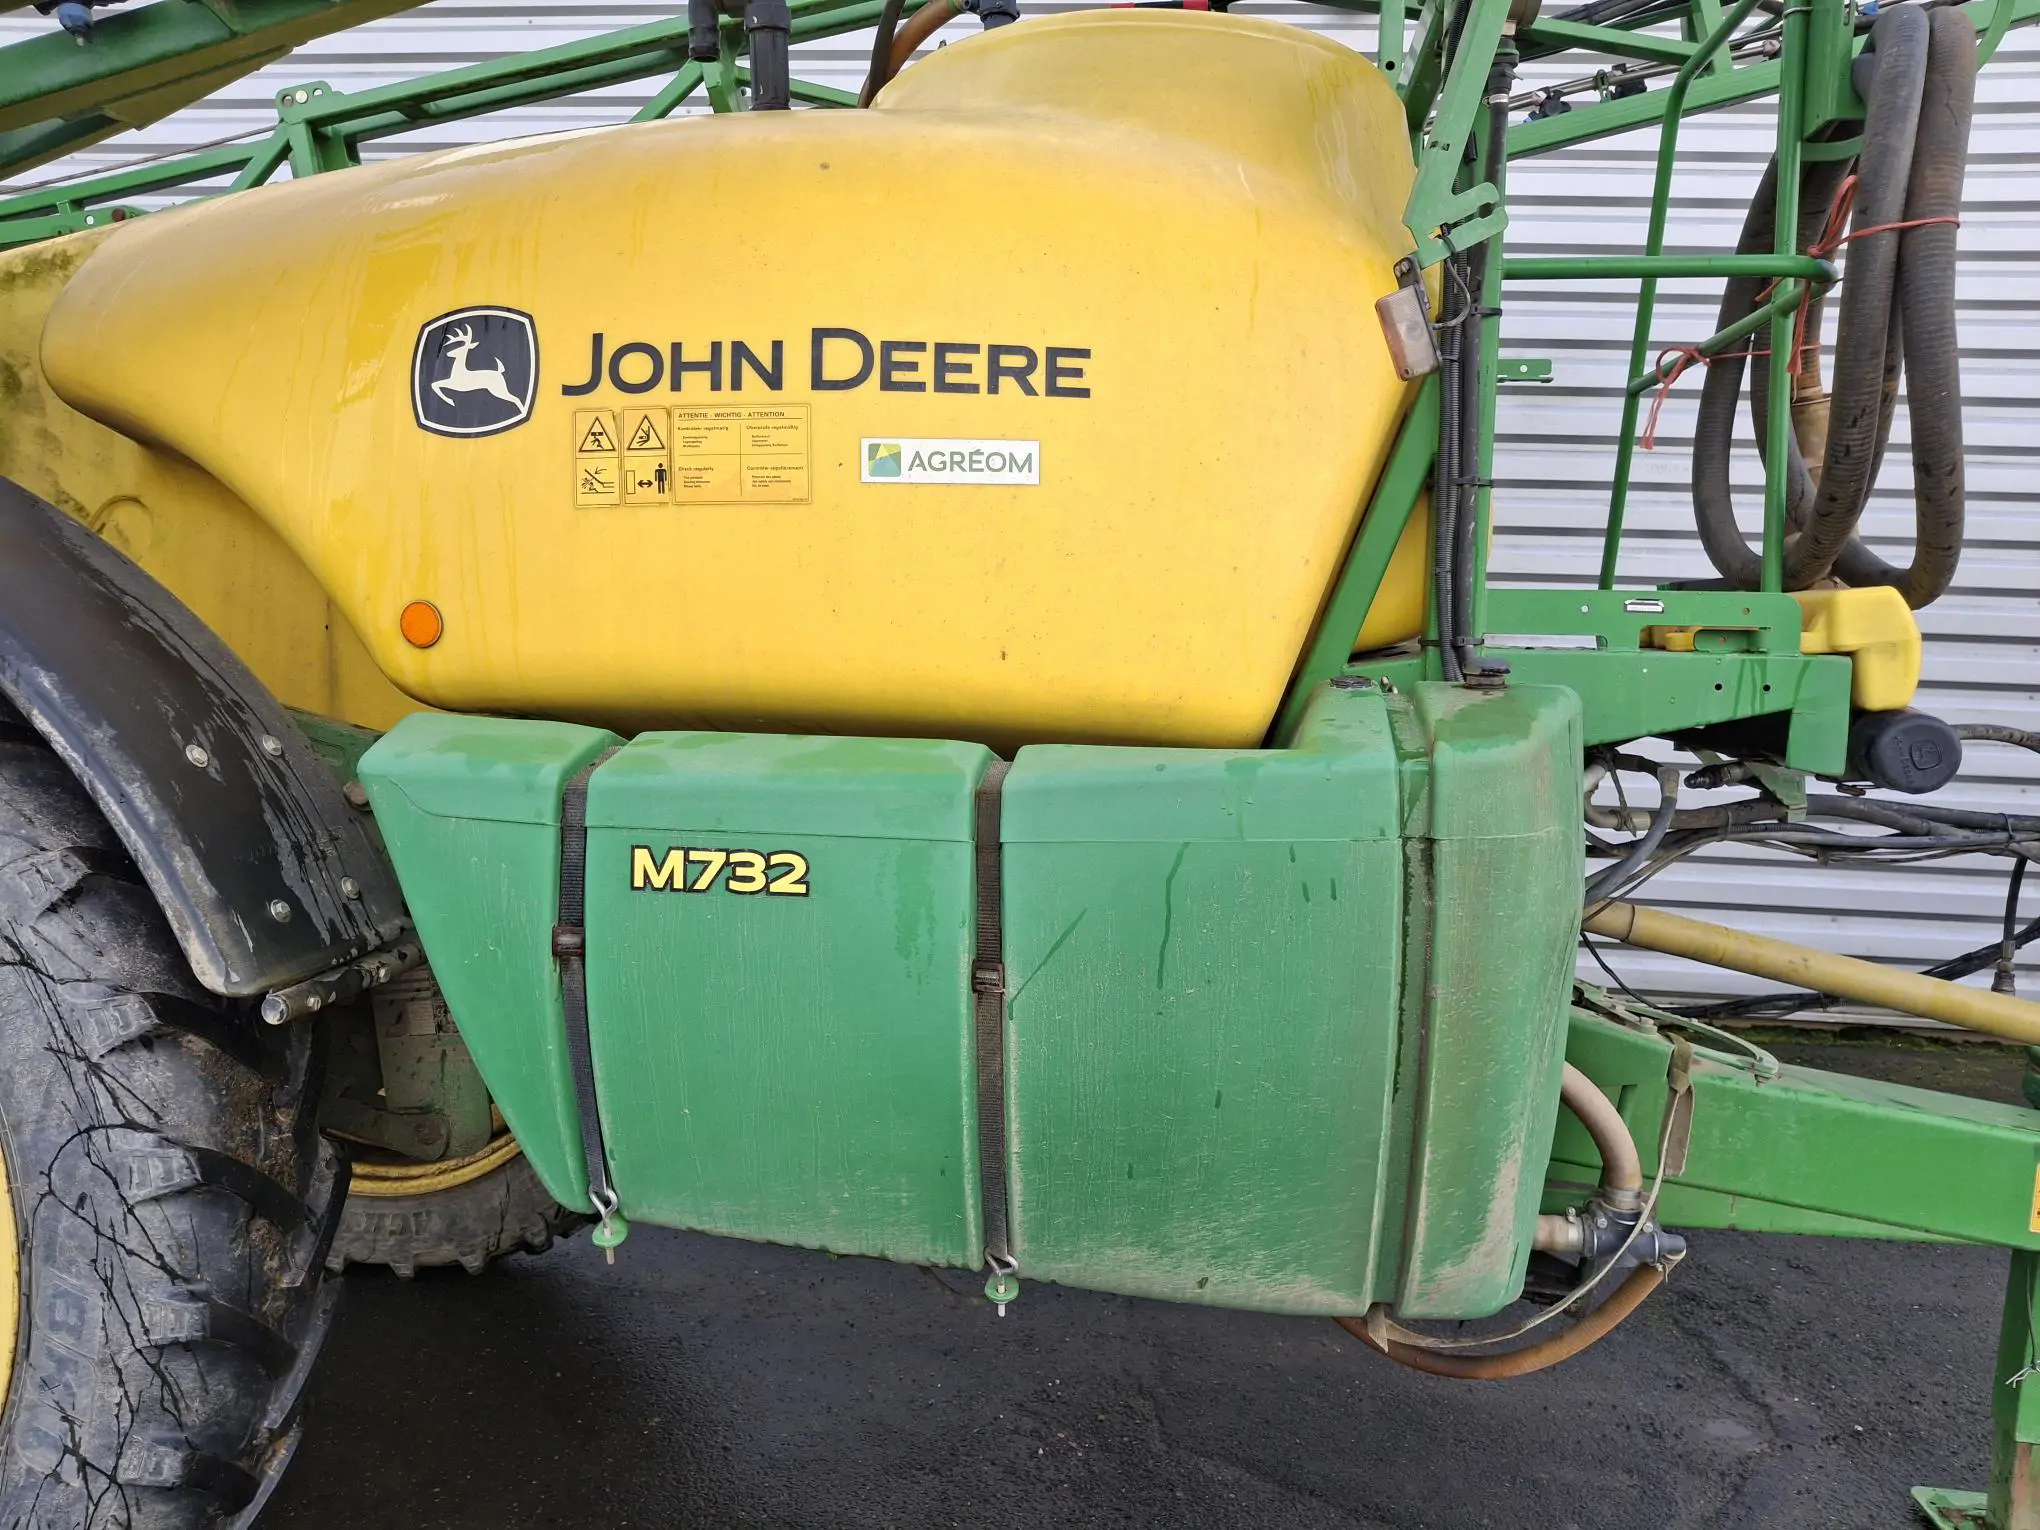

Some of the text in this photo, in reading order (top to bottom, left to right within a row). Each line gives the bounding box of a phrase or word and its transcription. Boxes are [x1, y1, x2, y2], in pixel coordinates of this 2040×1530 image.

[561, 328, 1091, 398] JOHN DEERE
[907, 447, 1033, 474] AGRÉOM
[630, 843, 810, 898] M732
